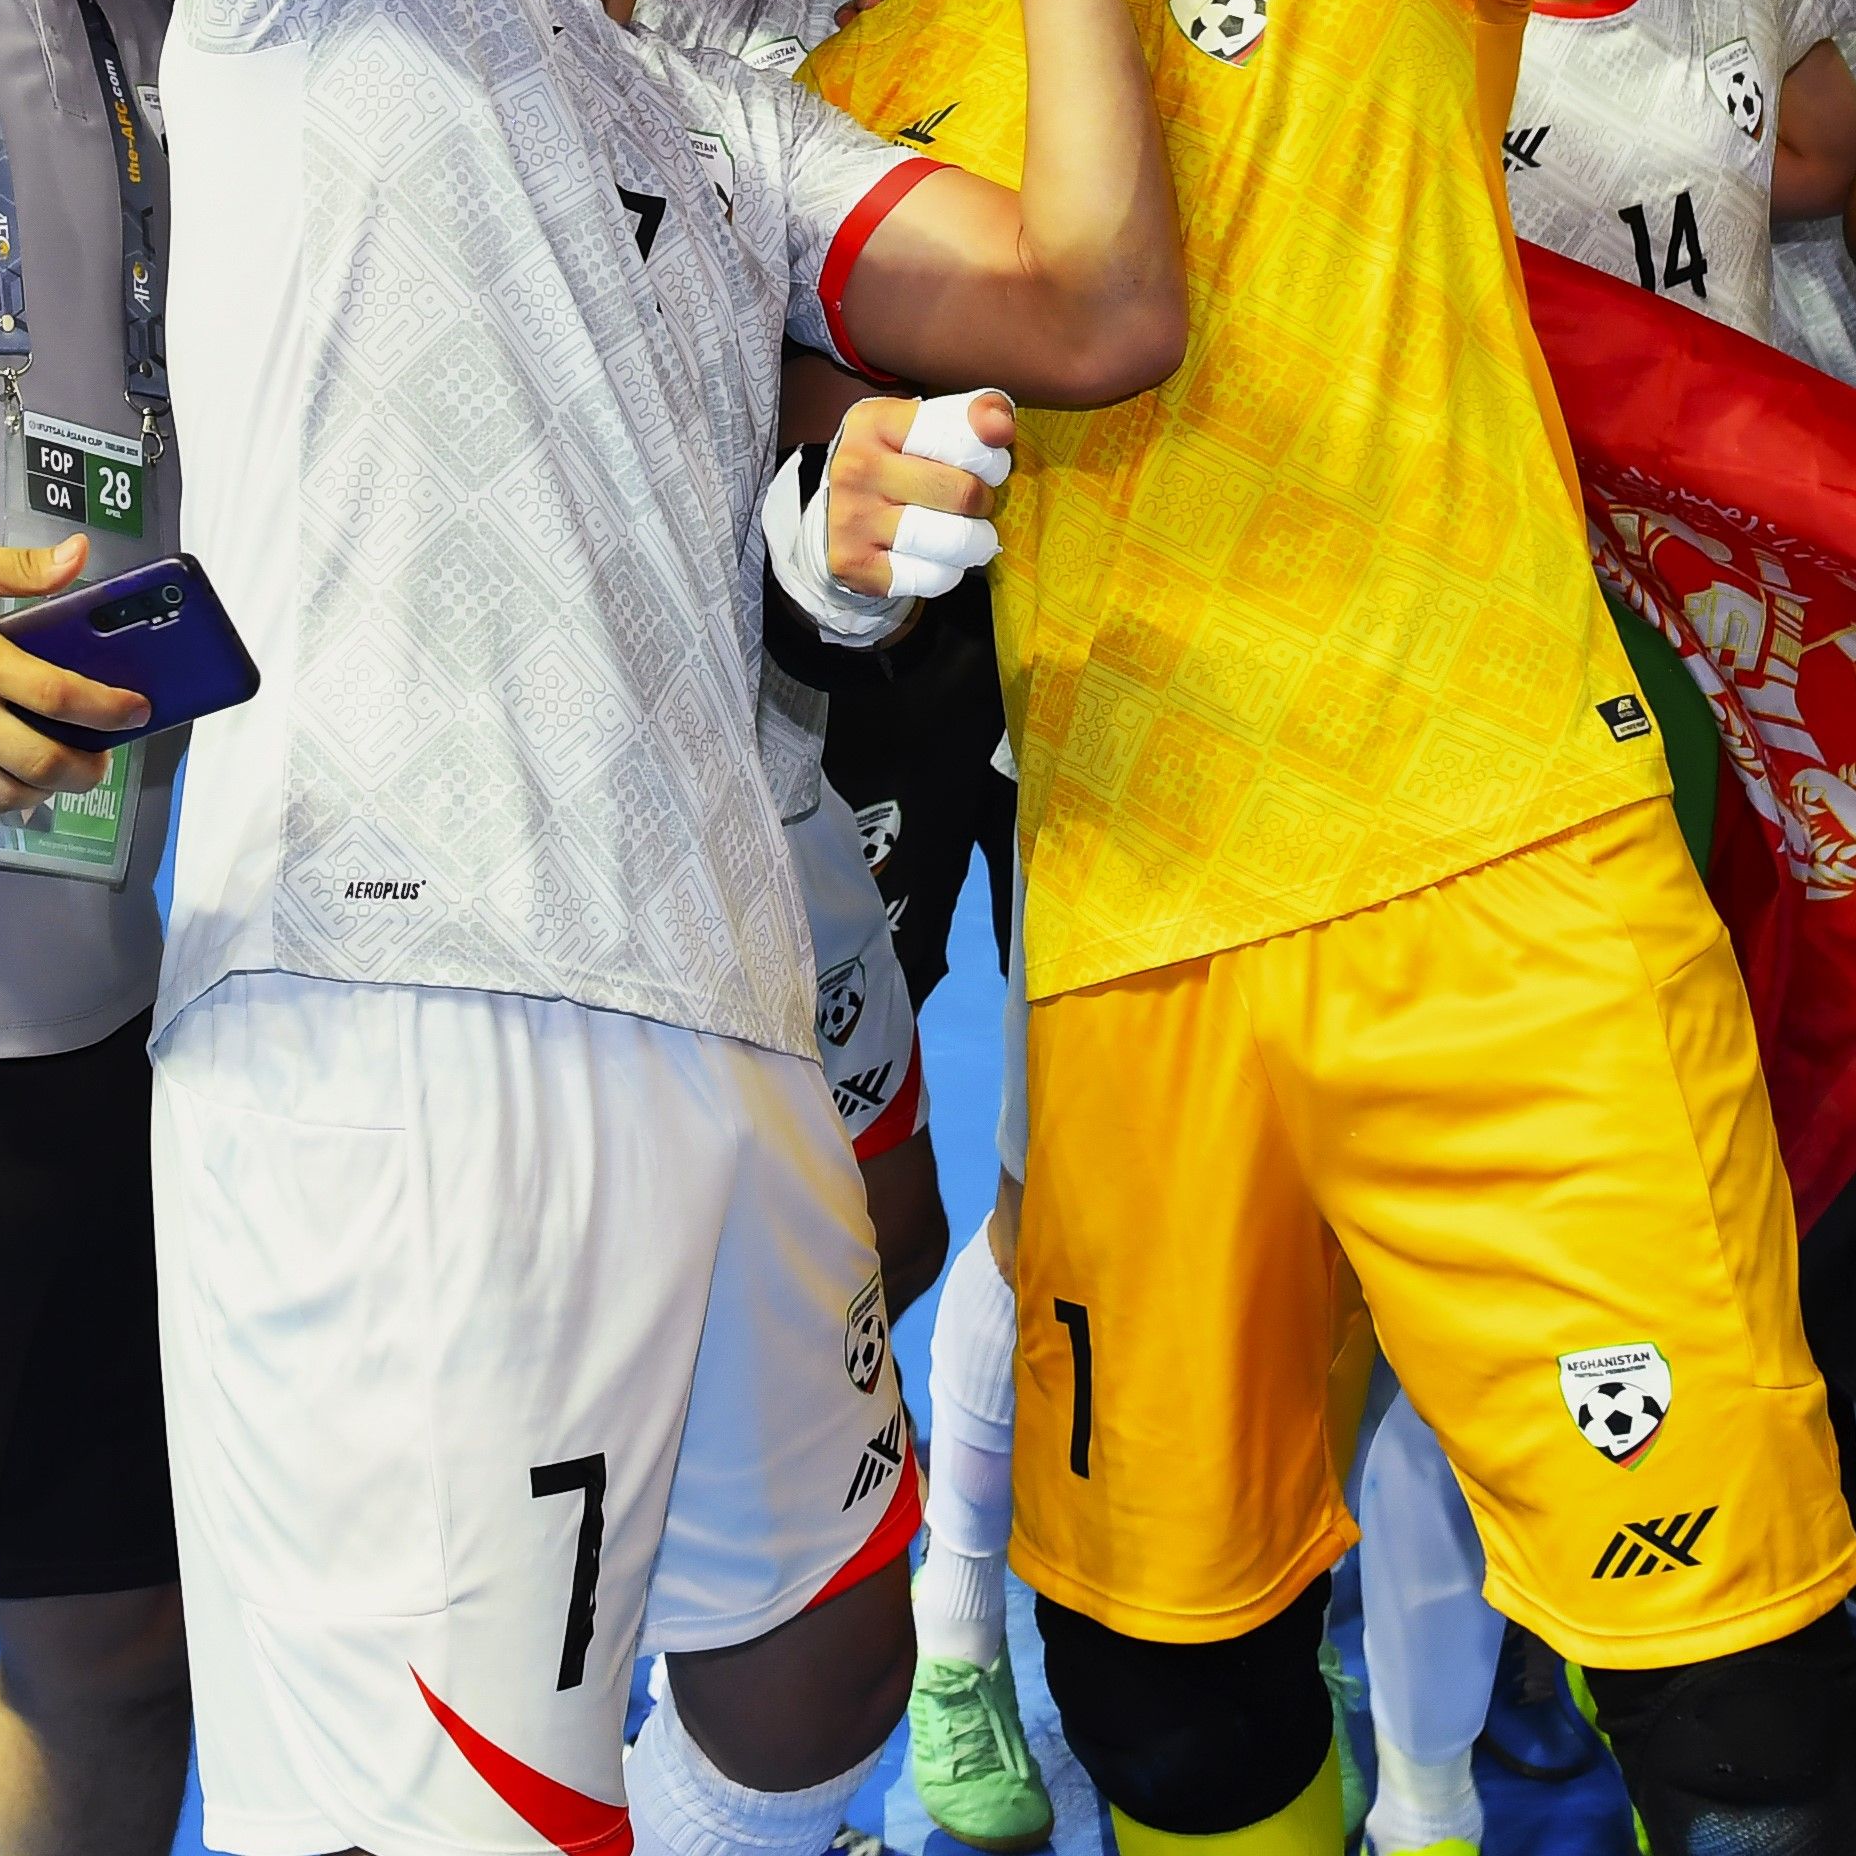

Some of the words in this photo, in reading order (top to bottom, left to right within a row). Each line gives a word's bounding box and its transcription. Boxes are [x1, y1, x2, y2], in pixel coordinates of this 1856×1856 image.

[104, 58, 142, 184] the-AFC.com
[1618, 190, 1707, 299] 14
[131, 263, 152, 313] AFC
[40, 446, 74, 475] FOP
[46, 483, 72, 511] OA
[98, 465, 132, 511] 28
[60, 787, 117, 821] OFFICIAL
[344, 880, 421, 901] AEROPLUS
[1567, 1351, 1651, 1372] AFGHANISTAN
[1053, 1297, 1094, 1479] 1
[530, 1452, 606, 1692] 7
